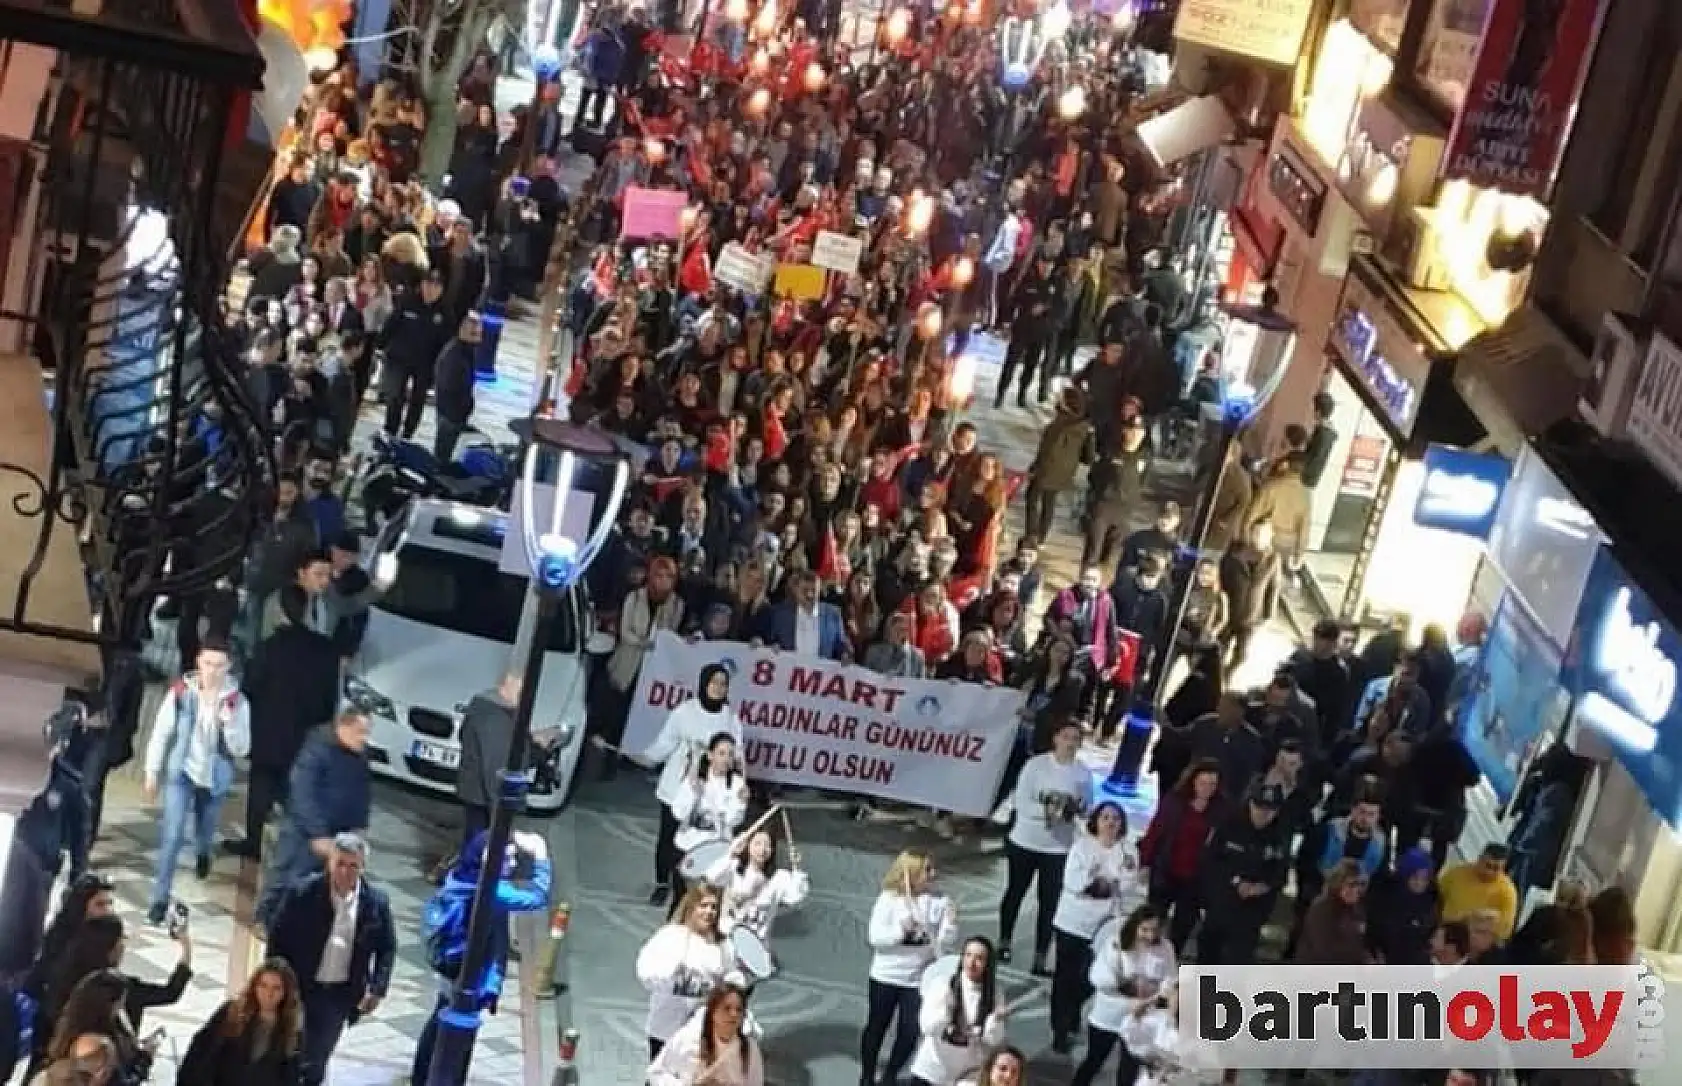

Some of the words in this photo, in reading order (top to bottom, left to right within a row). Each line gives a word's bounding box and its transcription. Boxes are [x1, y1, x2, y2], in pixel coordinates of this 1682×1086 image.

[753, 659, 776, 686] 8
[788, 666, 906, 713] MART
[737, 699, 859, 742] KADINLAR
[865, 721, 987, 763] GÜNÜNÜZ
[744, 739, 807, 771] UTLU
[813, 750, 895, 785] OLSUN
